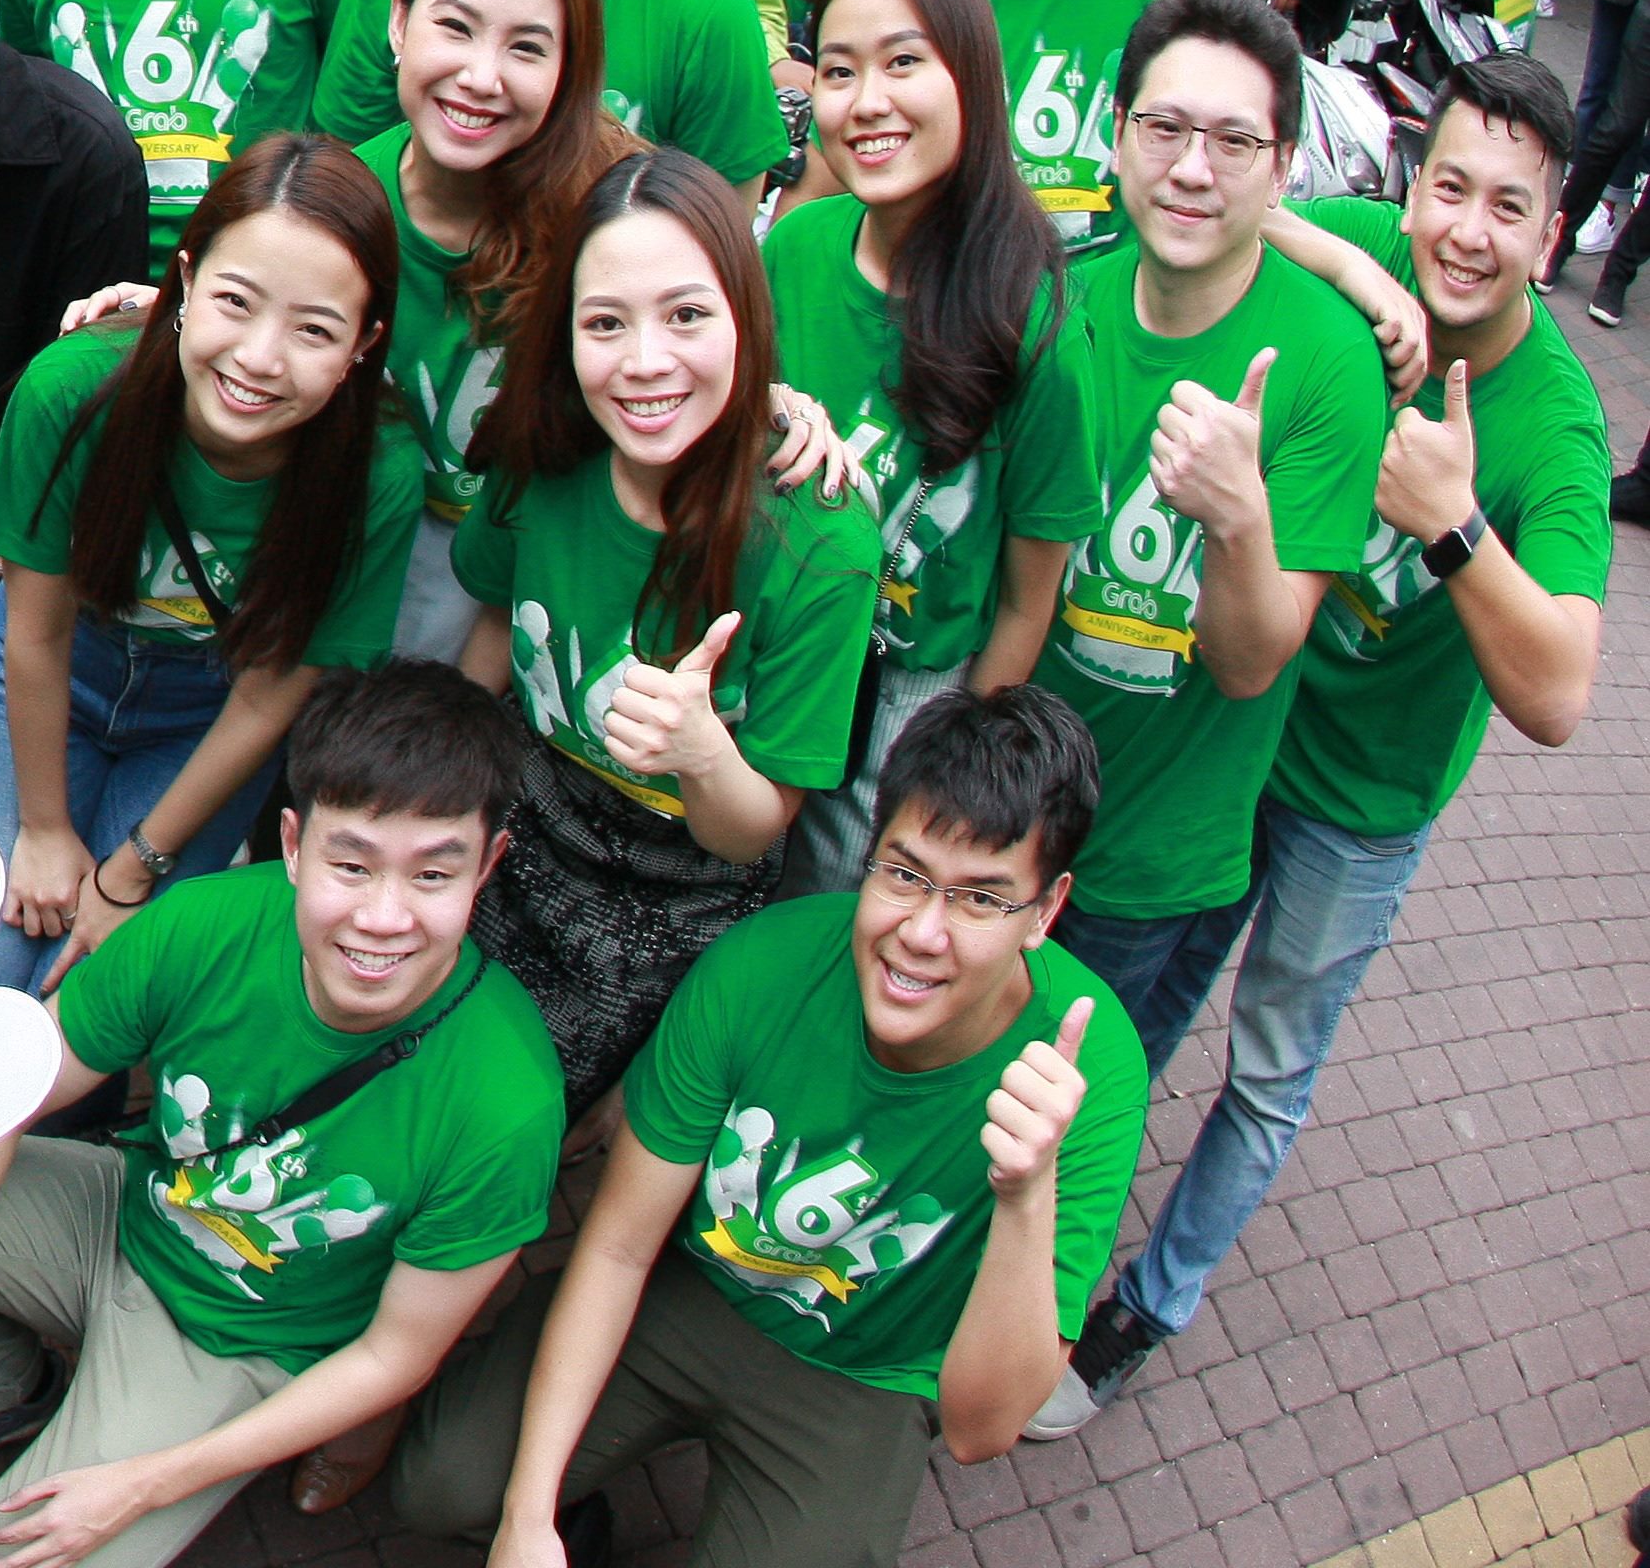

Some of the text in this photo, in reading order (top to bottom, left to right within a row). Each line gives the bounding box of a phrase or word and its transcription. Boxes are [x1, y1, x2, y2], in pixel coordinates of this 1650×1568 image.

[123, 0, 199, 104] 6th
[125, 105, 188, 133] Grab
[1014, 54, 1085, 157] 6th
[1016, 160, 1071, 186] Grab
[454, 472, 486, 497] Gr
[1101, 581, 1158, 620] Grab
[1085, 616, 1169, 645] ANNIVERSARY
